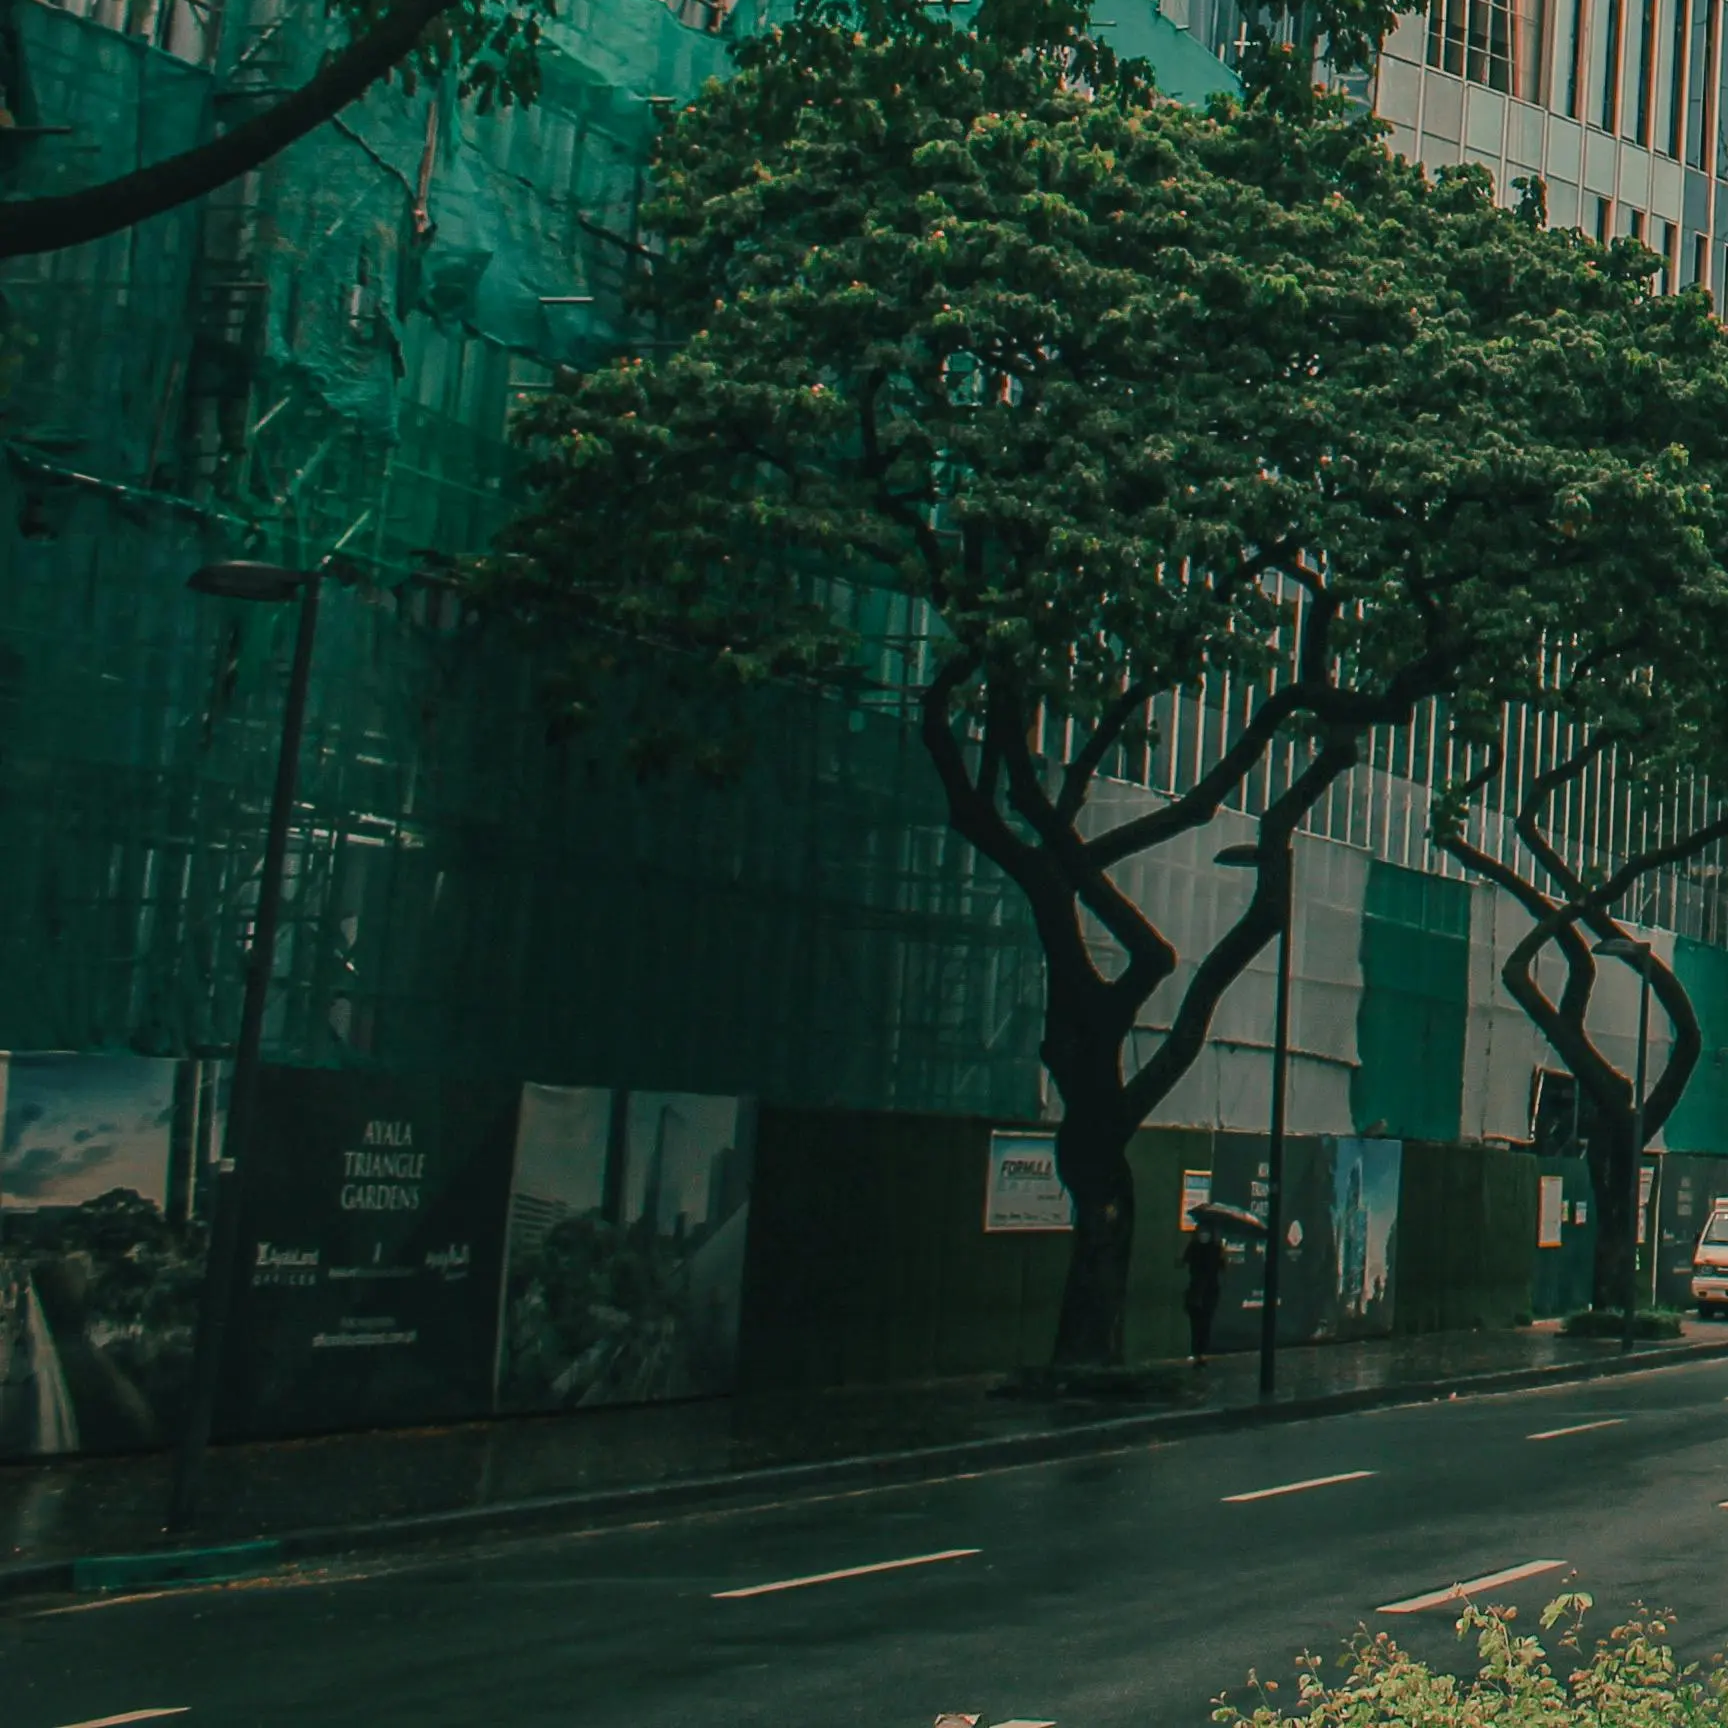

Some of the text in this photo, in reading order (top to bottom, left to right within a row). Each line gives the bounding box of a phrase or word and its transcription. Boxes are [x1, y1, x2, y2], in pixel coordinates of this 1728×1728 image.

[363, 1121, 412, 1146] AYALA
[344, 1152, 426, 1178] TRIANGLE
[341, 1184, 420, 1210] GARDENS
